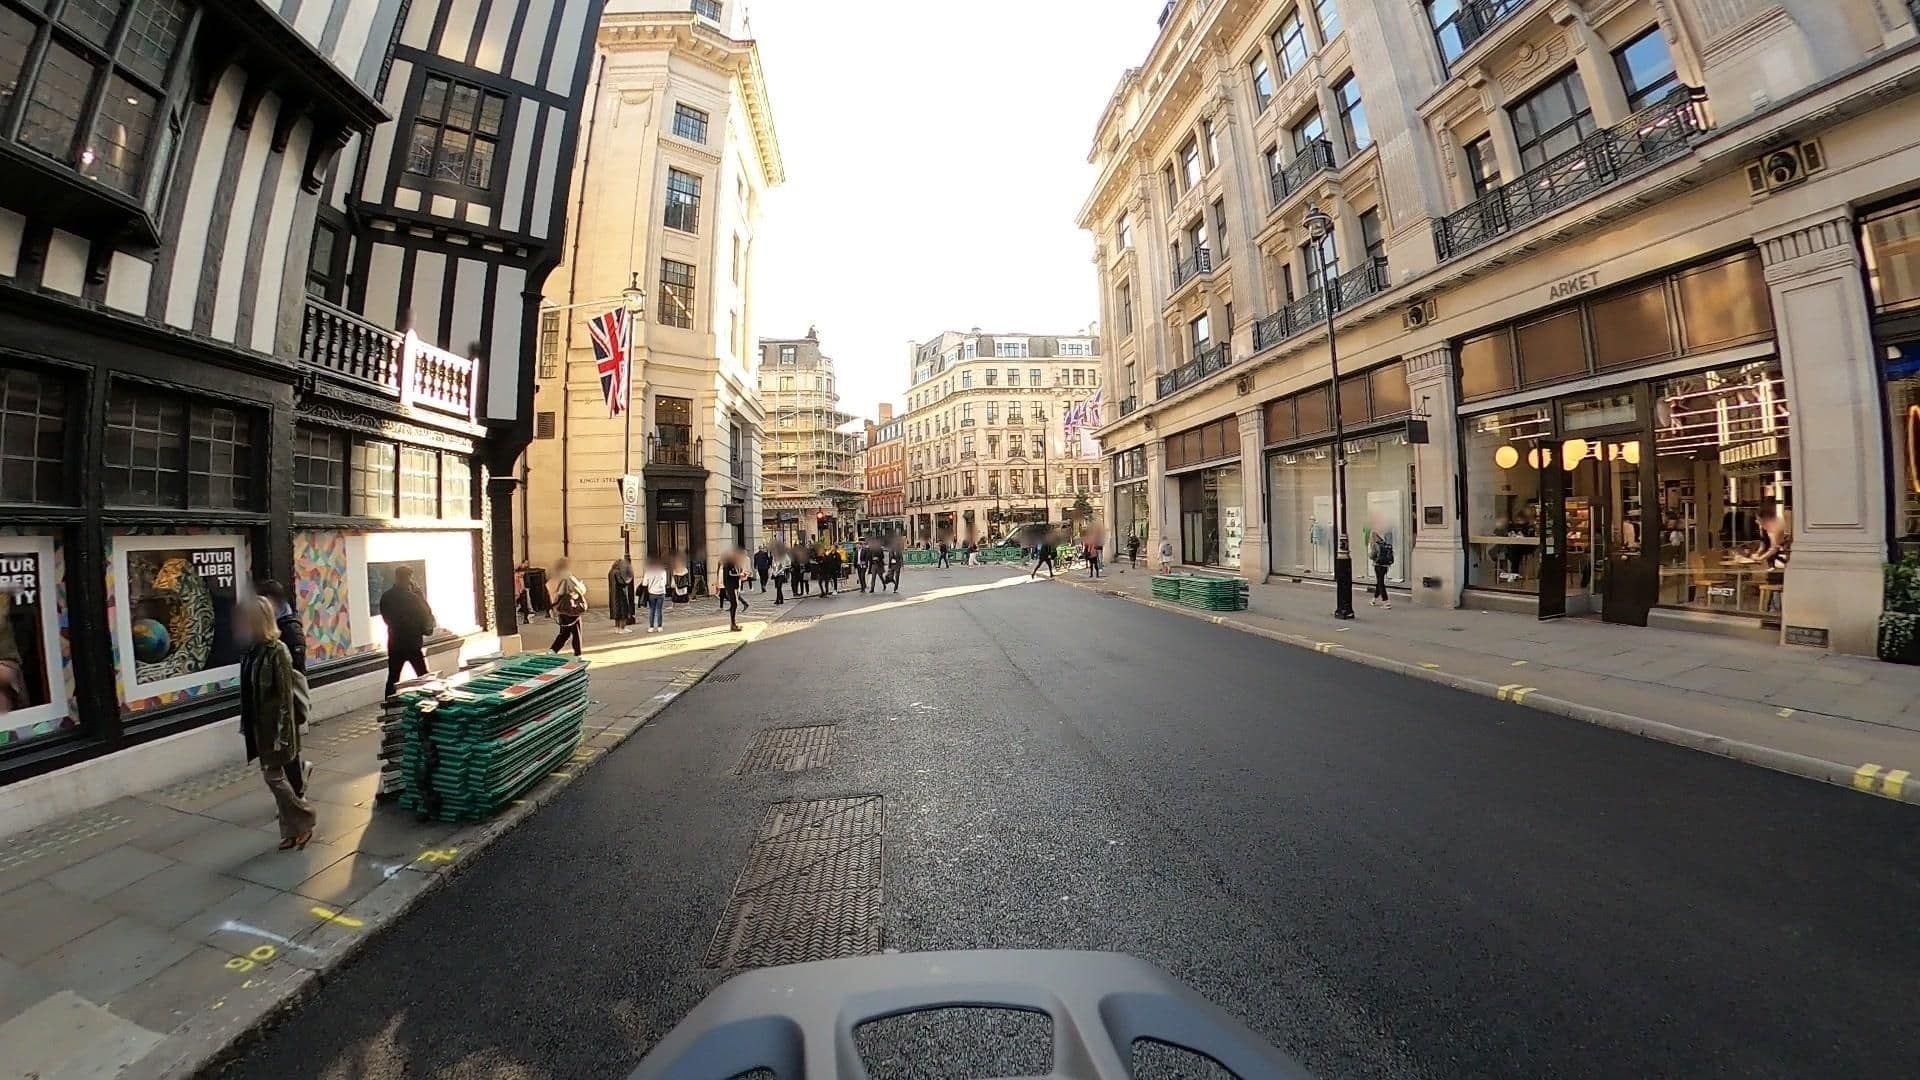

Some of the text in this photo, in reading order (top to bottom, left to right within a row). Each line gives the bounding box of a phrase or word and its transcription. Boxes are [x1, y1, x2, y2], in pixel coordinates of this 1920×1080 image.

[1550, 270, 1600, 300] ARKET
[192, 551, 232, 564] FUTUR
[198, 563, 232, 576] LIBER
[217, 576, 233, 587] TY
[15, 590, 36, 605] TY
